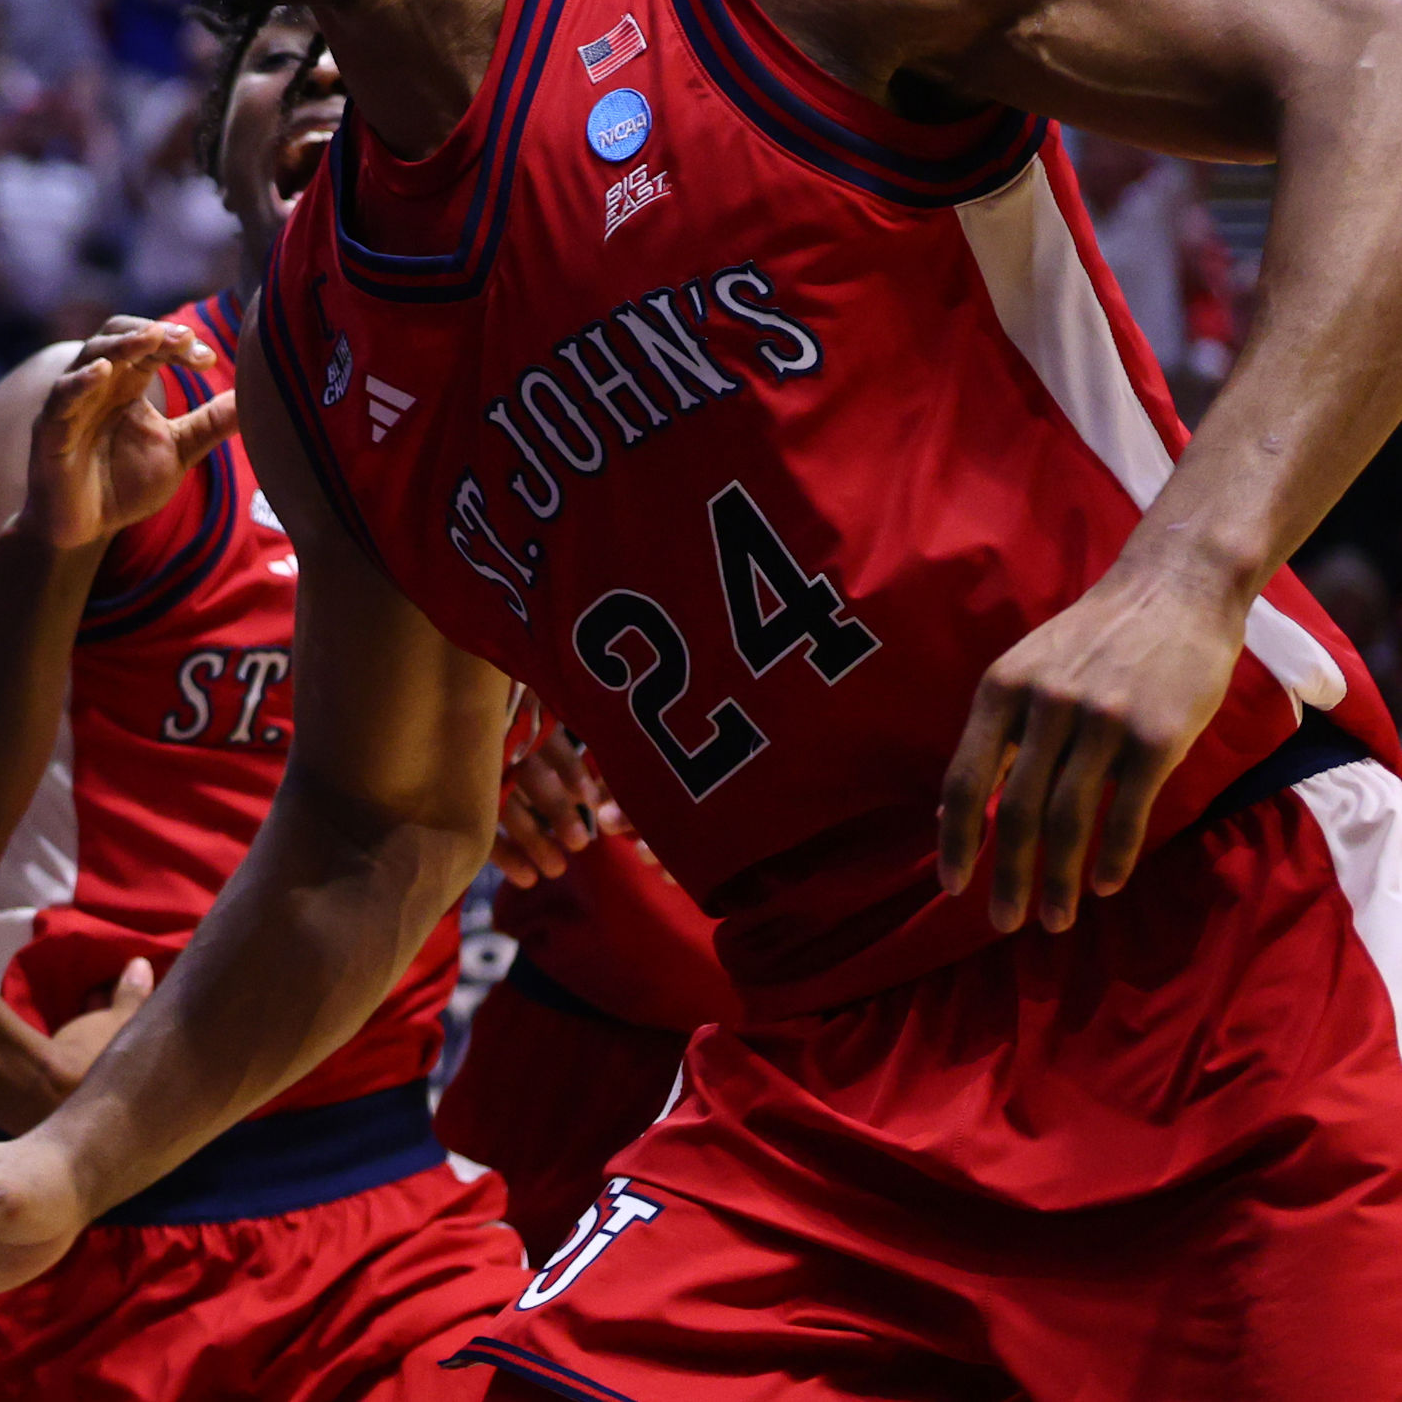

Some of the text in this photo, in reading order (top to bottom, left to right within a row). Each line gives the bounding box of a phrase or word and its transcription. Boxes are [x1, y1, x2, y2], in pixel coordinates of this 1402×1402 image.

[598, 112, 648, 149] NCAA
[605, 163, 648, 210] BIG
[605, 170, 669, 231] EAST
[445, 259, 824, 632] ST. JOHN'S
[573, 480, 882, 802] 24
[161, 644, 292, 746] ST.
